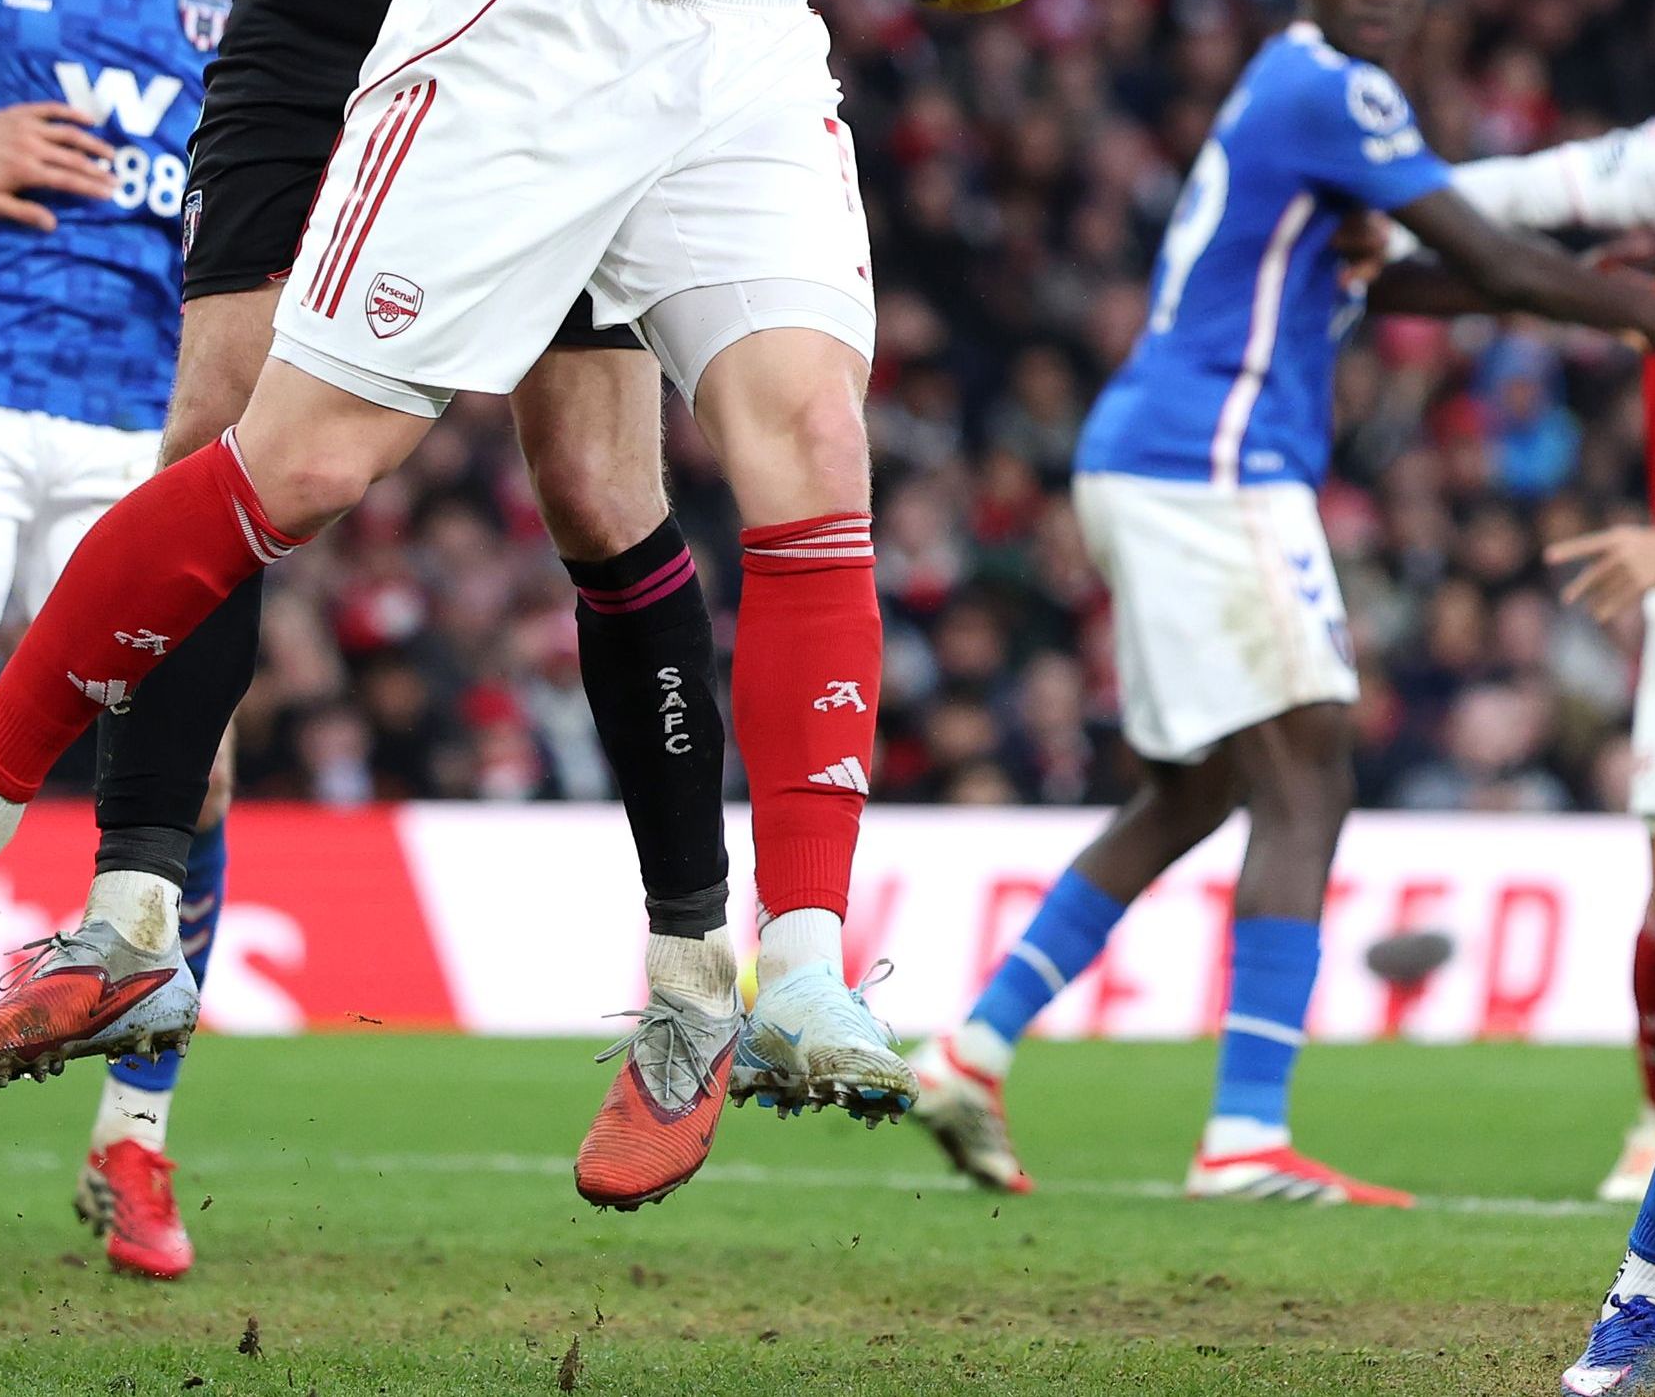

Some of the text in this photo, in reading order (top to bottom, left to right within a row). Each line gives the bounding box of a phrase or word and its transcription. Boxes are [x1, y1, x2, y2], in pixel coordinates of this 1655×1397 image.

[97, 146, 187, 217] 88
[377, 282, 416, 305] Arsenal
[657, 666, 693, 755] SAFC
